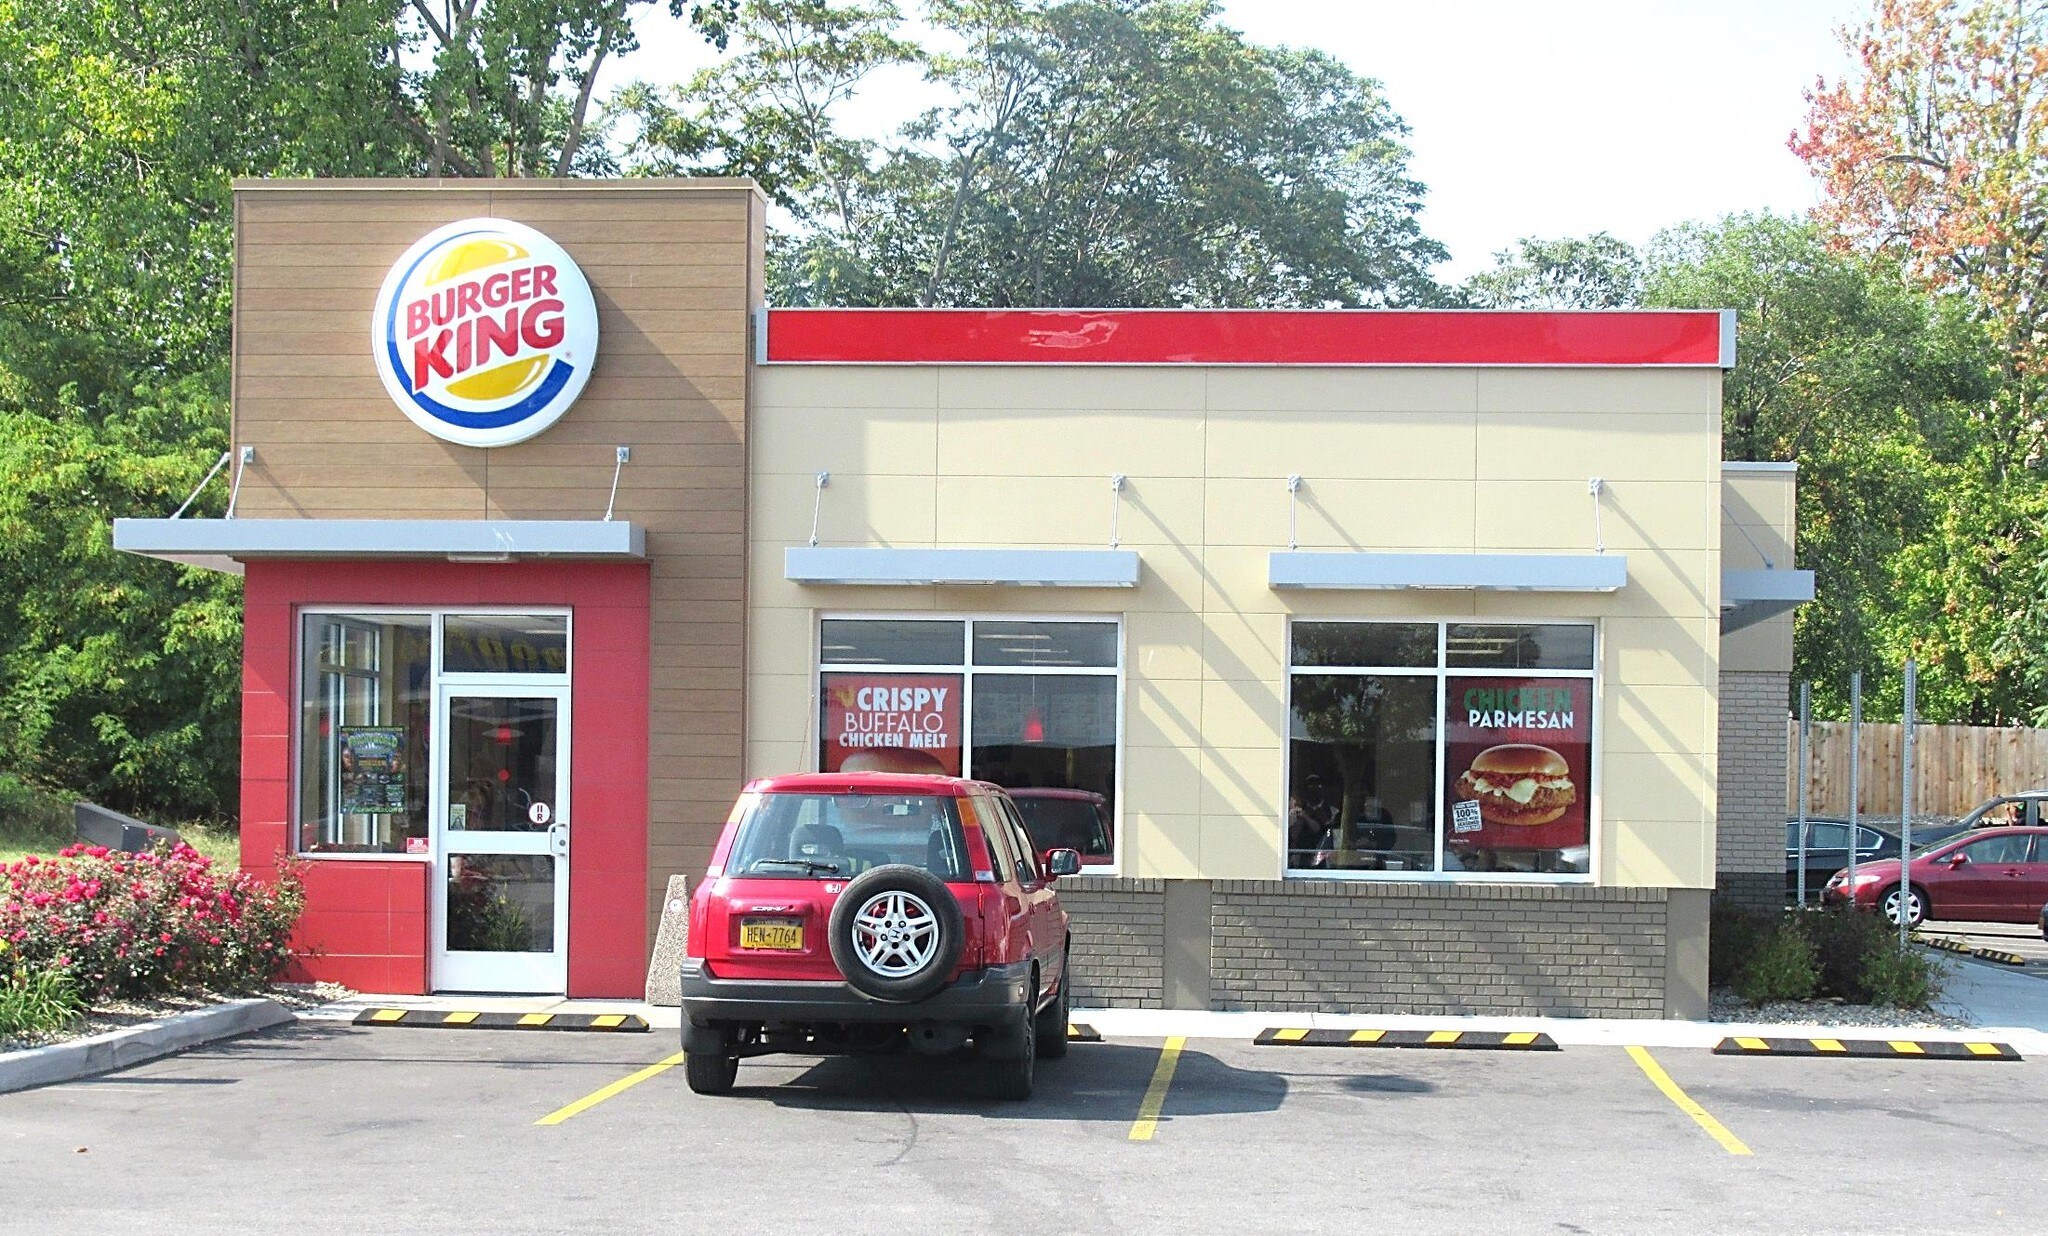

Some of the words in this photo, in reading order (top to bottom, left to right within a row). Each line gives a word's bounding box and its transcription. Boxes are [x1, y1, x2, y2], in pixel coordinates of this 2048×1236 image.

[407, 265, 558, 340] BURGER
[414, 298, 565, 391] KING
[857, 686, 948, 712] CRISPY
[1464, 688, 1571, 712] CHICKEN
[845, 712, 944, 734] BUFFALO
[1468, 709, 1574, 729] PARMESAN
[839, 732, 903, 748] CHICKEN
[909, 733, 948, 749] MELT
[1456, 809, 1477, 817] 100%
